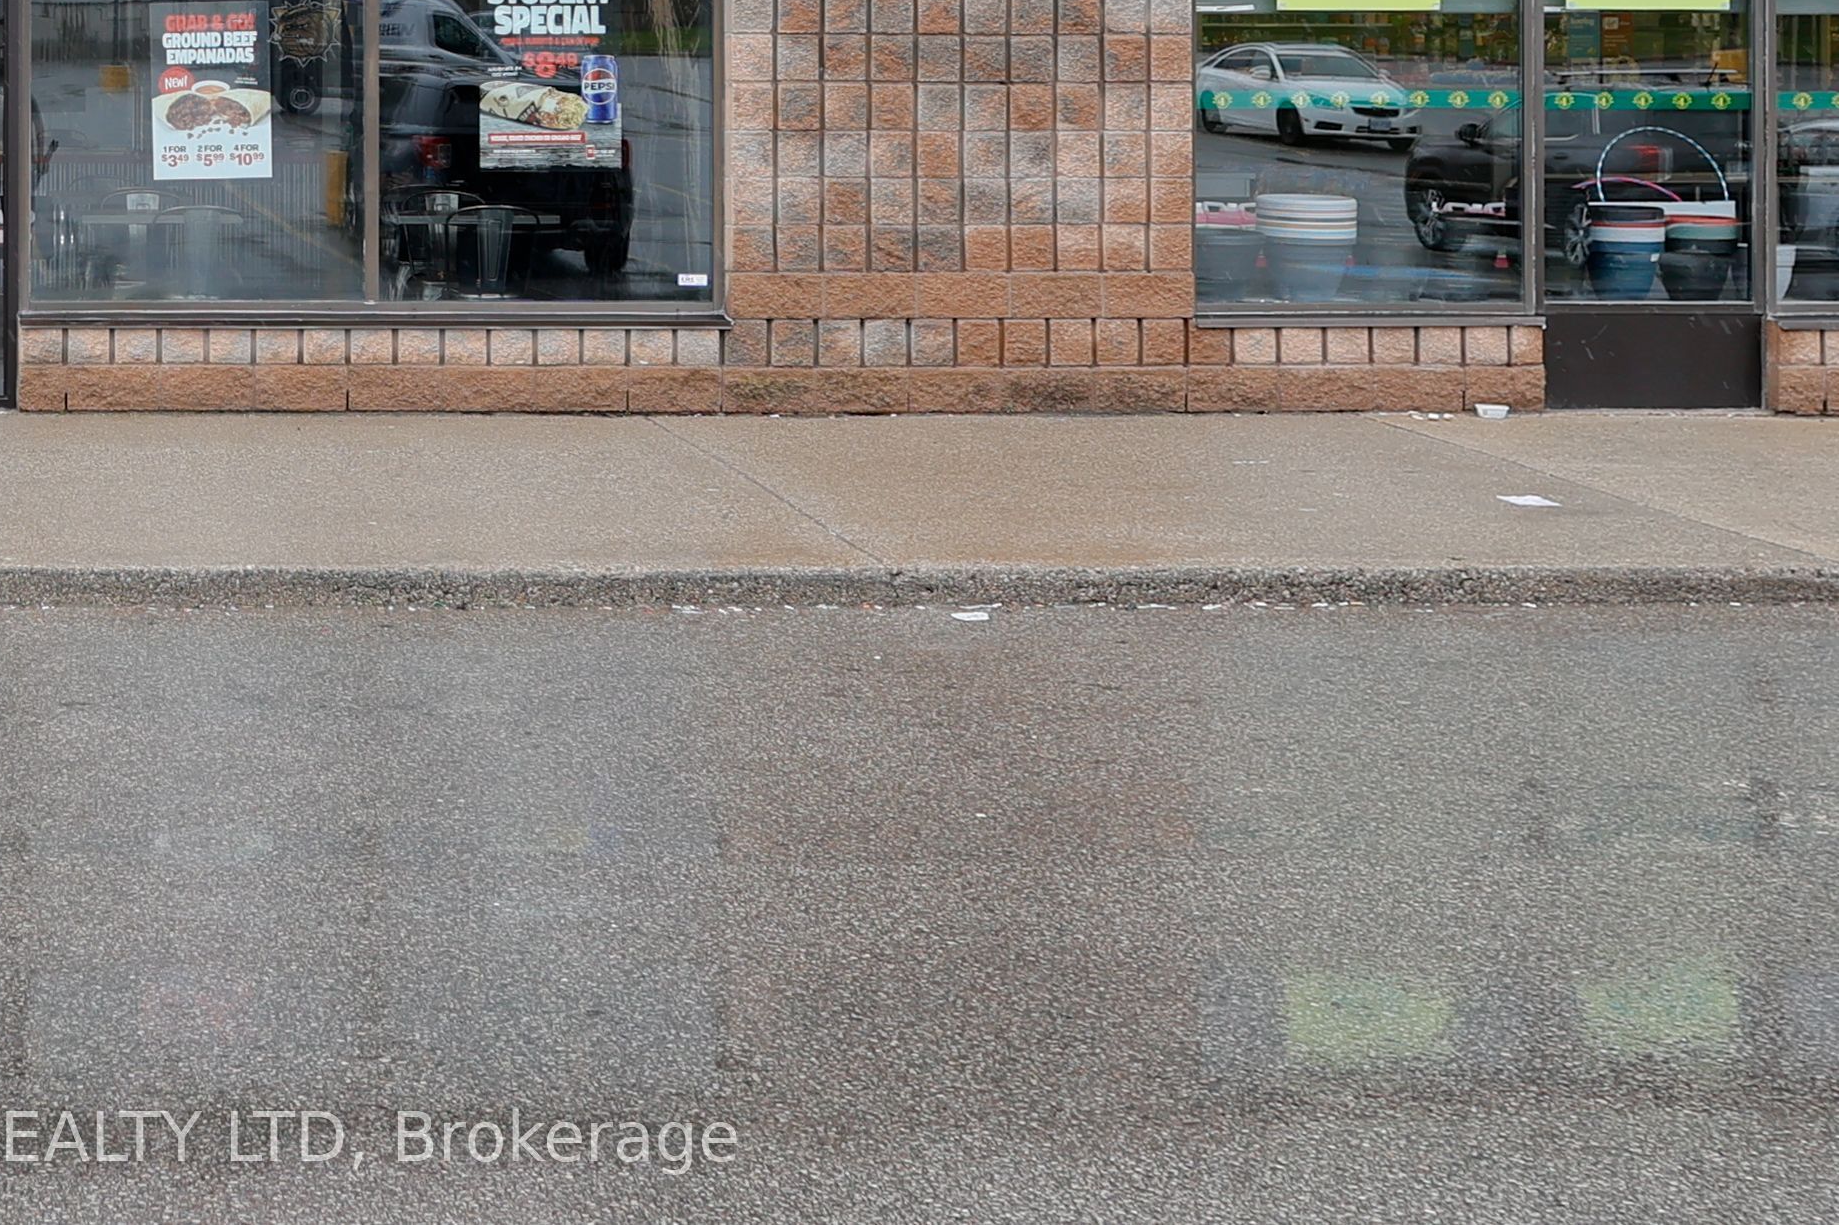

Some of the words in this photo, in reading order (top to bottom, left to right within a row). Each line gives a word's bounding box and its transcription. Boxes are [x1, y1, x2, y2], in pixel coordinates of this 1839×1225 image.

[165, 14, 208, 32] GRAB
[212, 14, 224, 31] &
[493, 4, 607, 35] SPECIAL
[162, 32, 222, 49] GROUND
[223, 30, 258, 47] BEEF
[165, 47, 255, 65] EMPANADAS
[164, 75, 188, 91] NEW!
[583, 81, 616, 92] PEPSI
[168, 145, 187, 153] FOR
[204, 144, 223, 153] FOR
[240, 143, 260, 152] FOR
